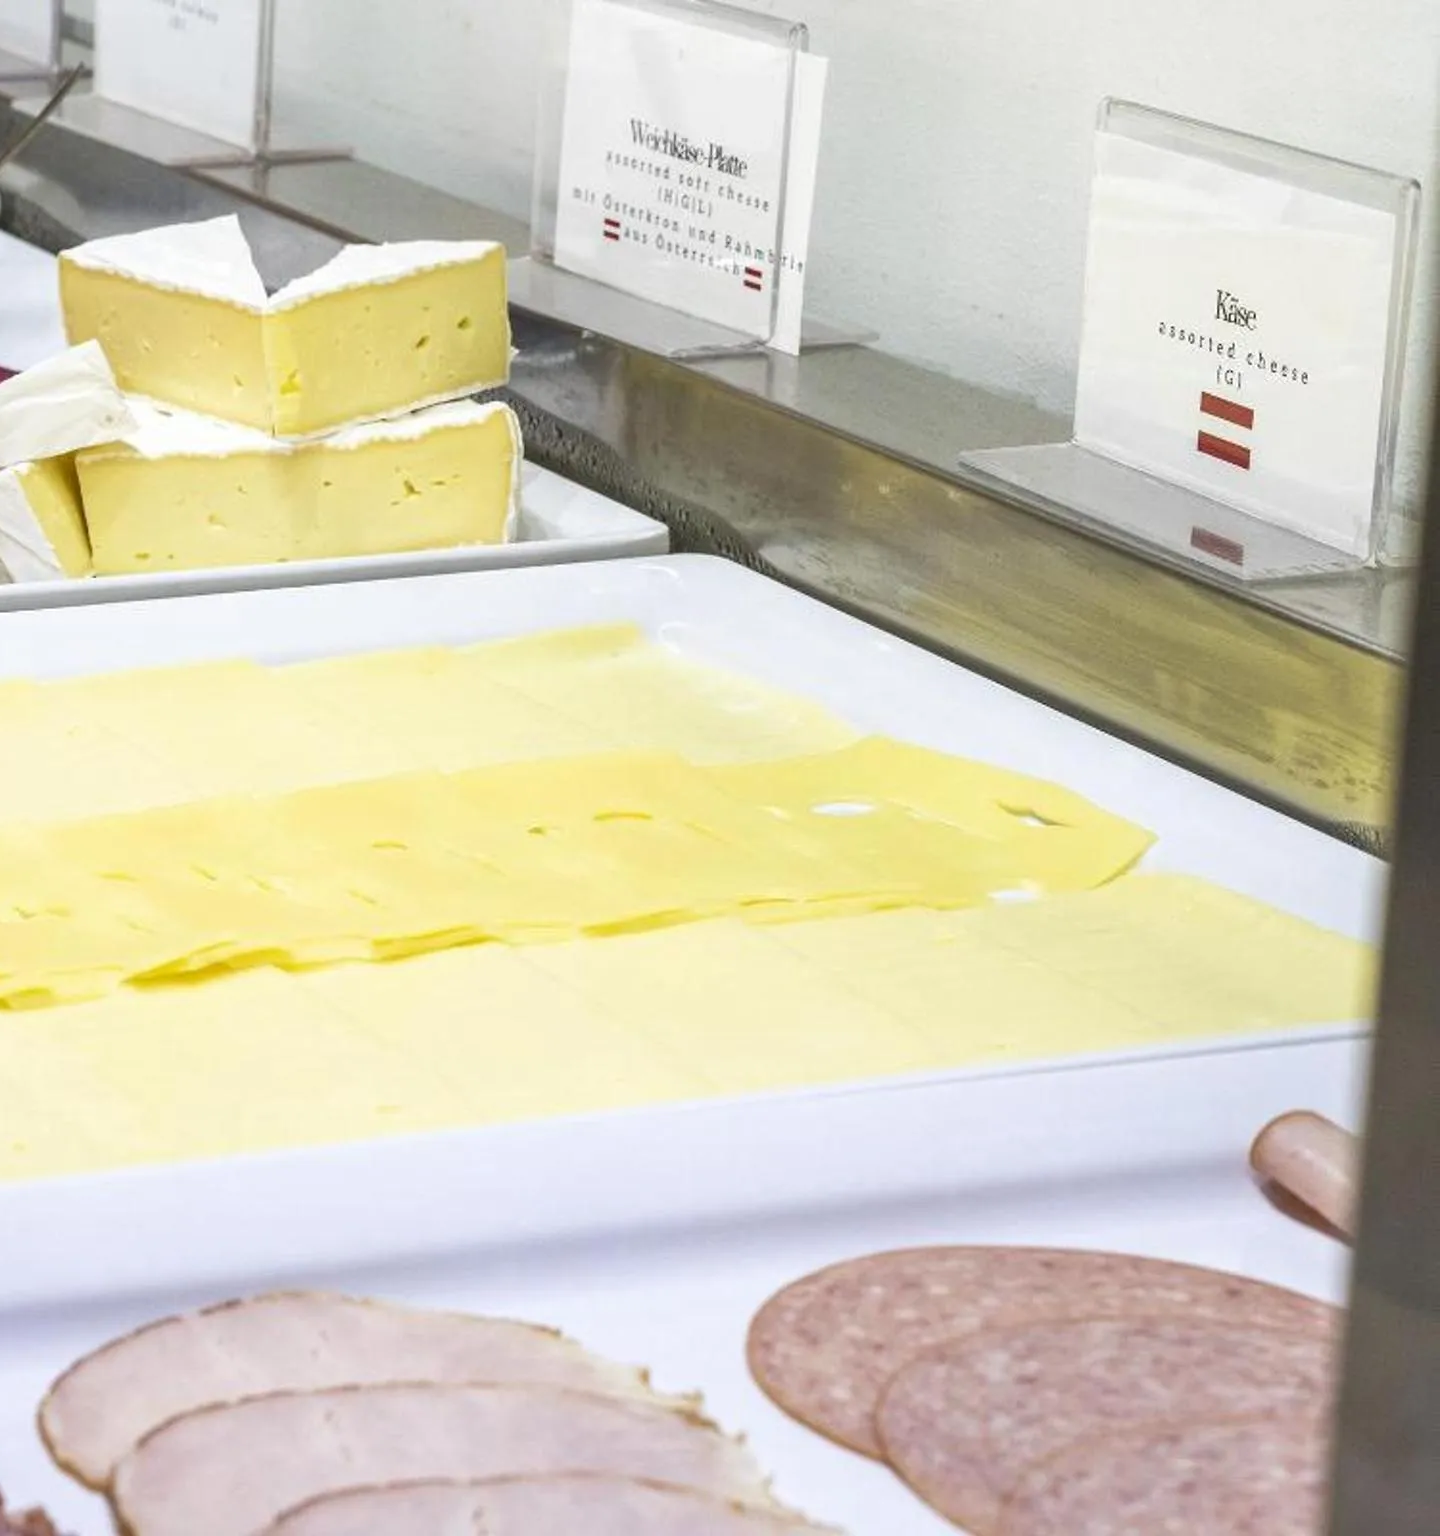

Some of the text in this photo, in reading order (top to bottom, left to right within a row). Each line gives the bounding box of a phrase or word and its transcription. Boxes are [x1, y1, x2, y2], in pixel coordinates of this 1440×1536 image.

[629, 118, 747, 178] Weichkäse-Platte
[606, 152, 769, 212] assorted soft cheese
[624, 227, 647, 244] aus
[689, 226, 716, 244] und
[1215, 289, 1257, 331] Käse
[1158, 322, 1309, 385] assorted cheese
